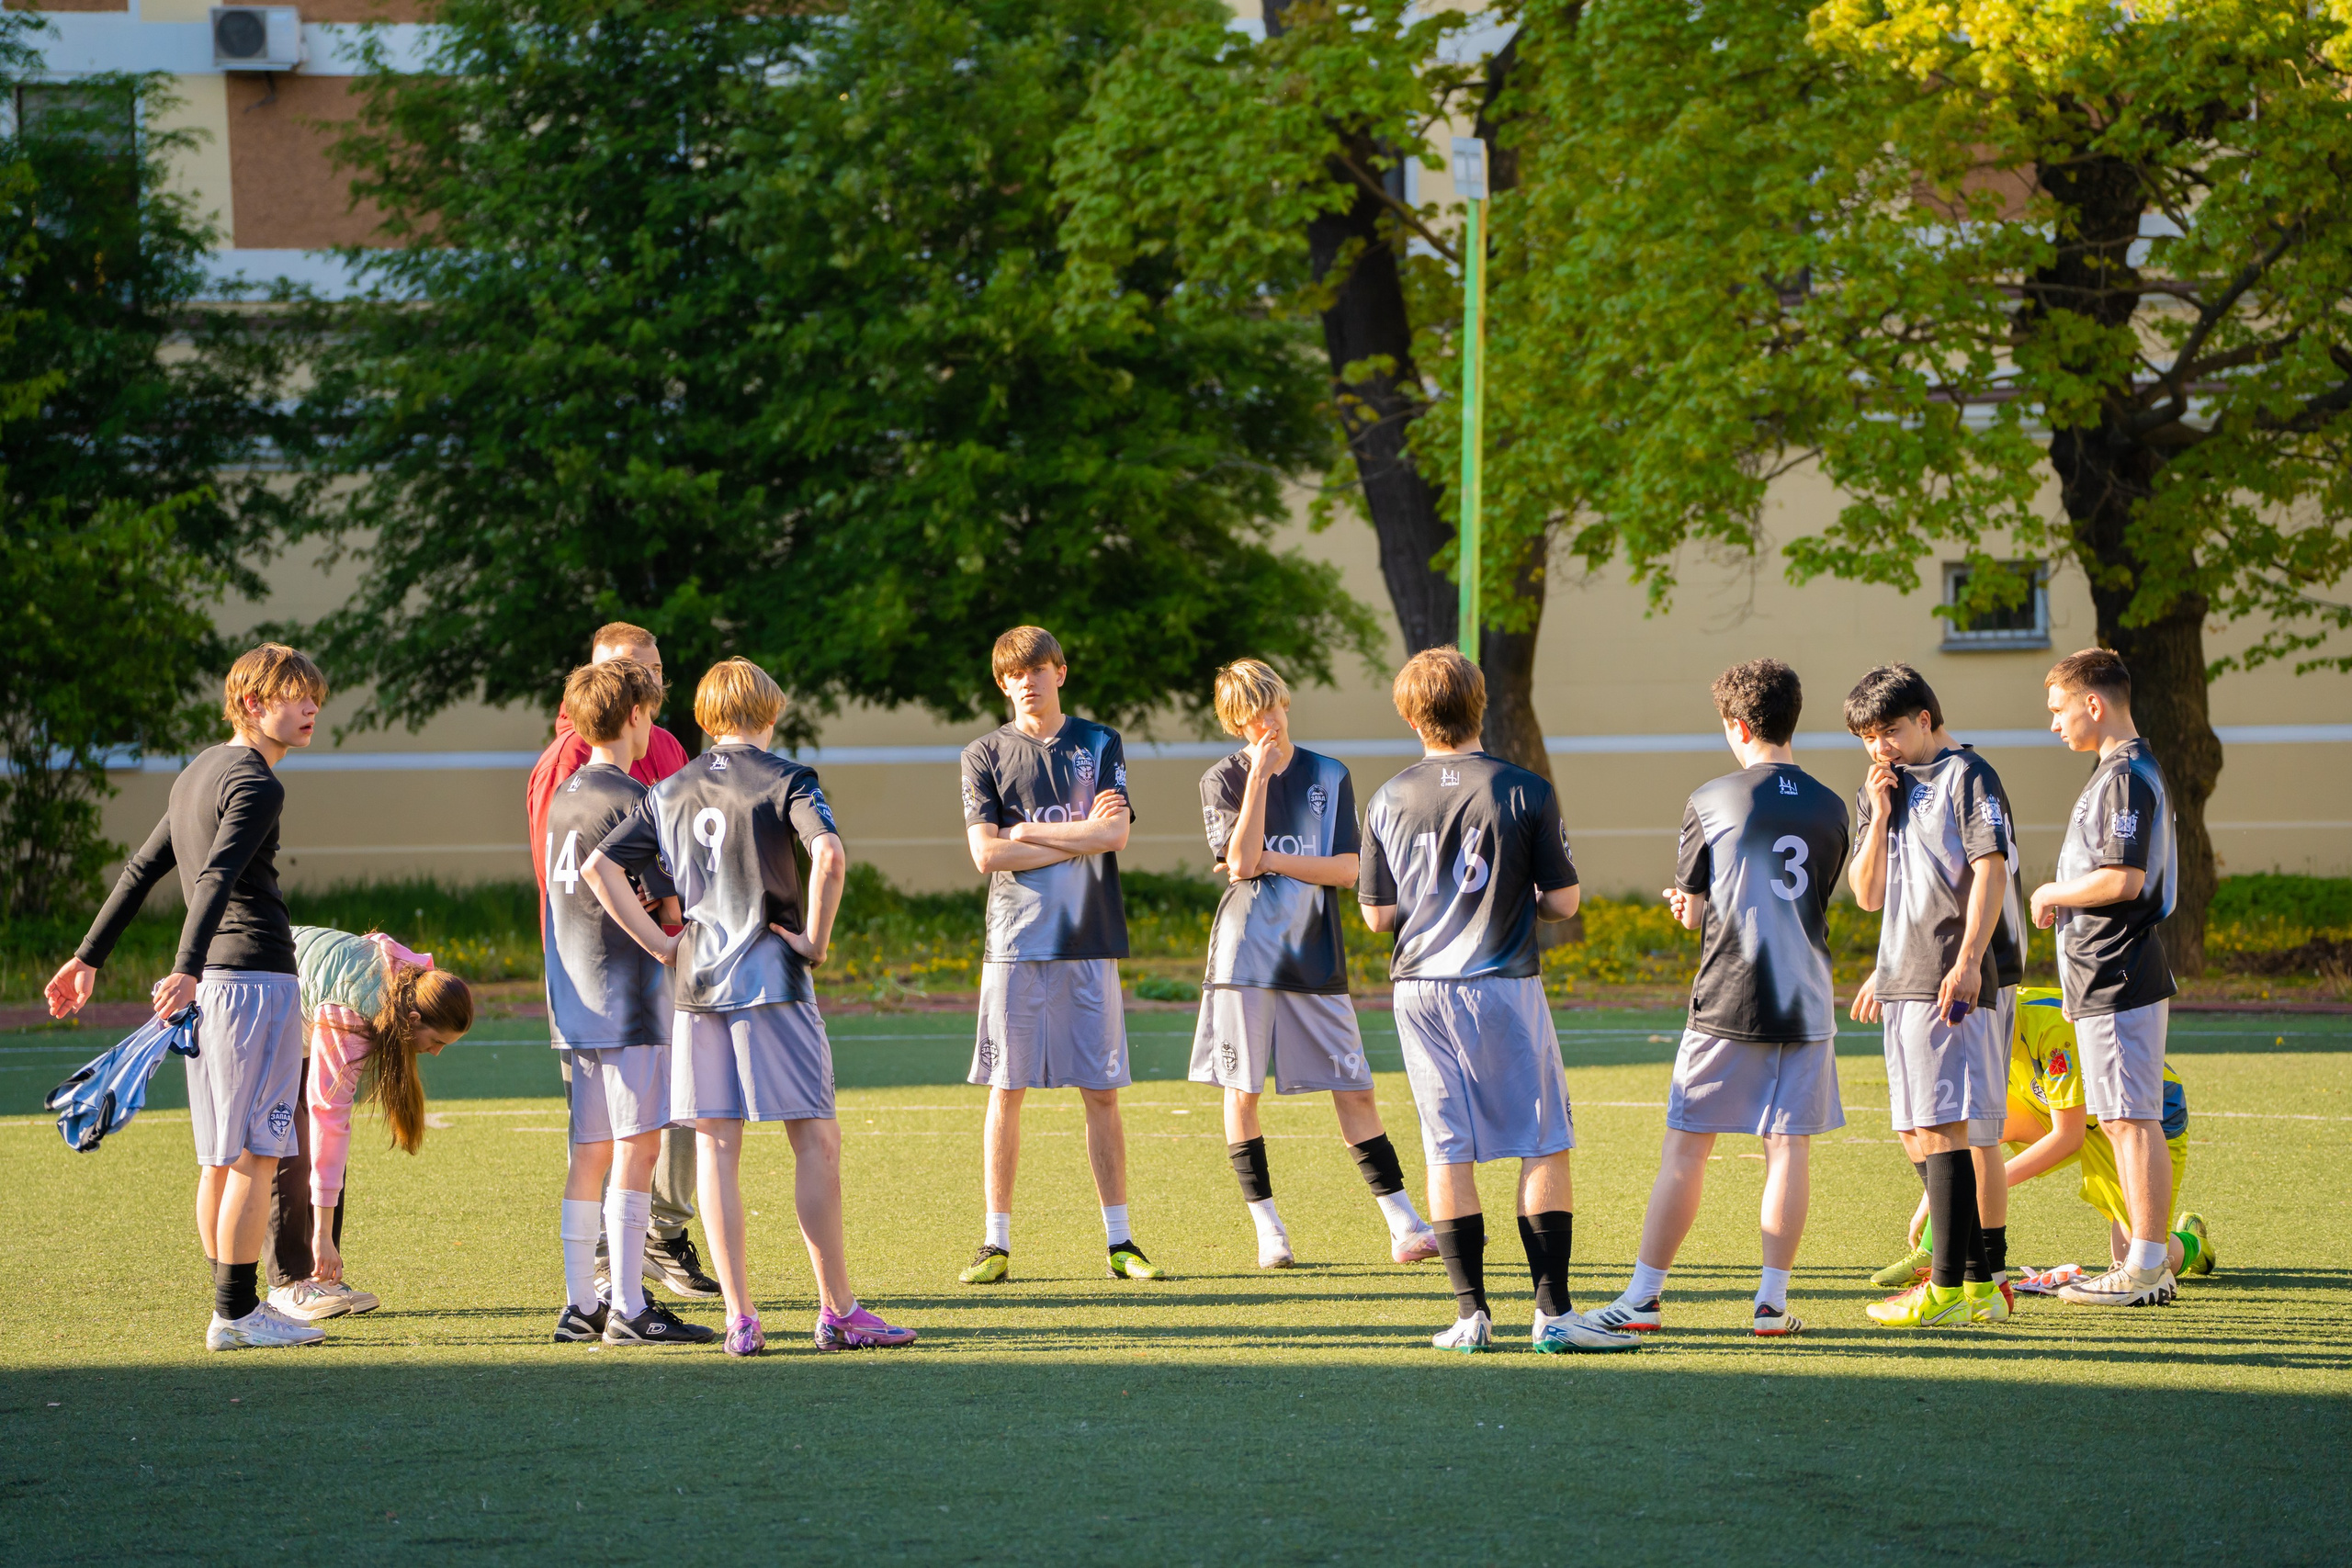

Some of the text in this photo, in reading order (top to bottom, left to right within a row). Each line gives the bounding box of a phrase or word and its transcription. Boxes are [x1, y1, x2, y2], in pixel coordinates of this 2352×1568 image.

[546, 829, 579, 895] 14
[693, 807, 727, 874] 9
[1414, 826, 1489, 896] 16
[1770, 834, 1809, 901] 3
[1105, 1049, 1121, 1078] 5
[1329, 1053, 1361, 1080] 19
[1934, 1078, 1958, 1111] 2
[2098, 1076, 2114, 1107] 1
